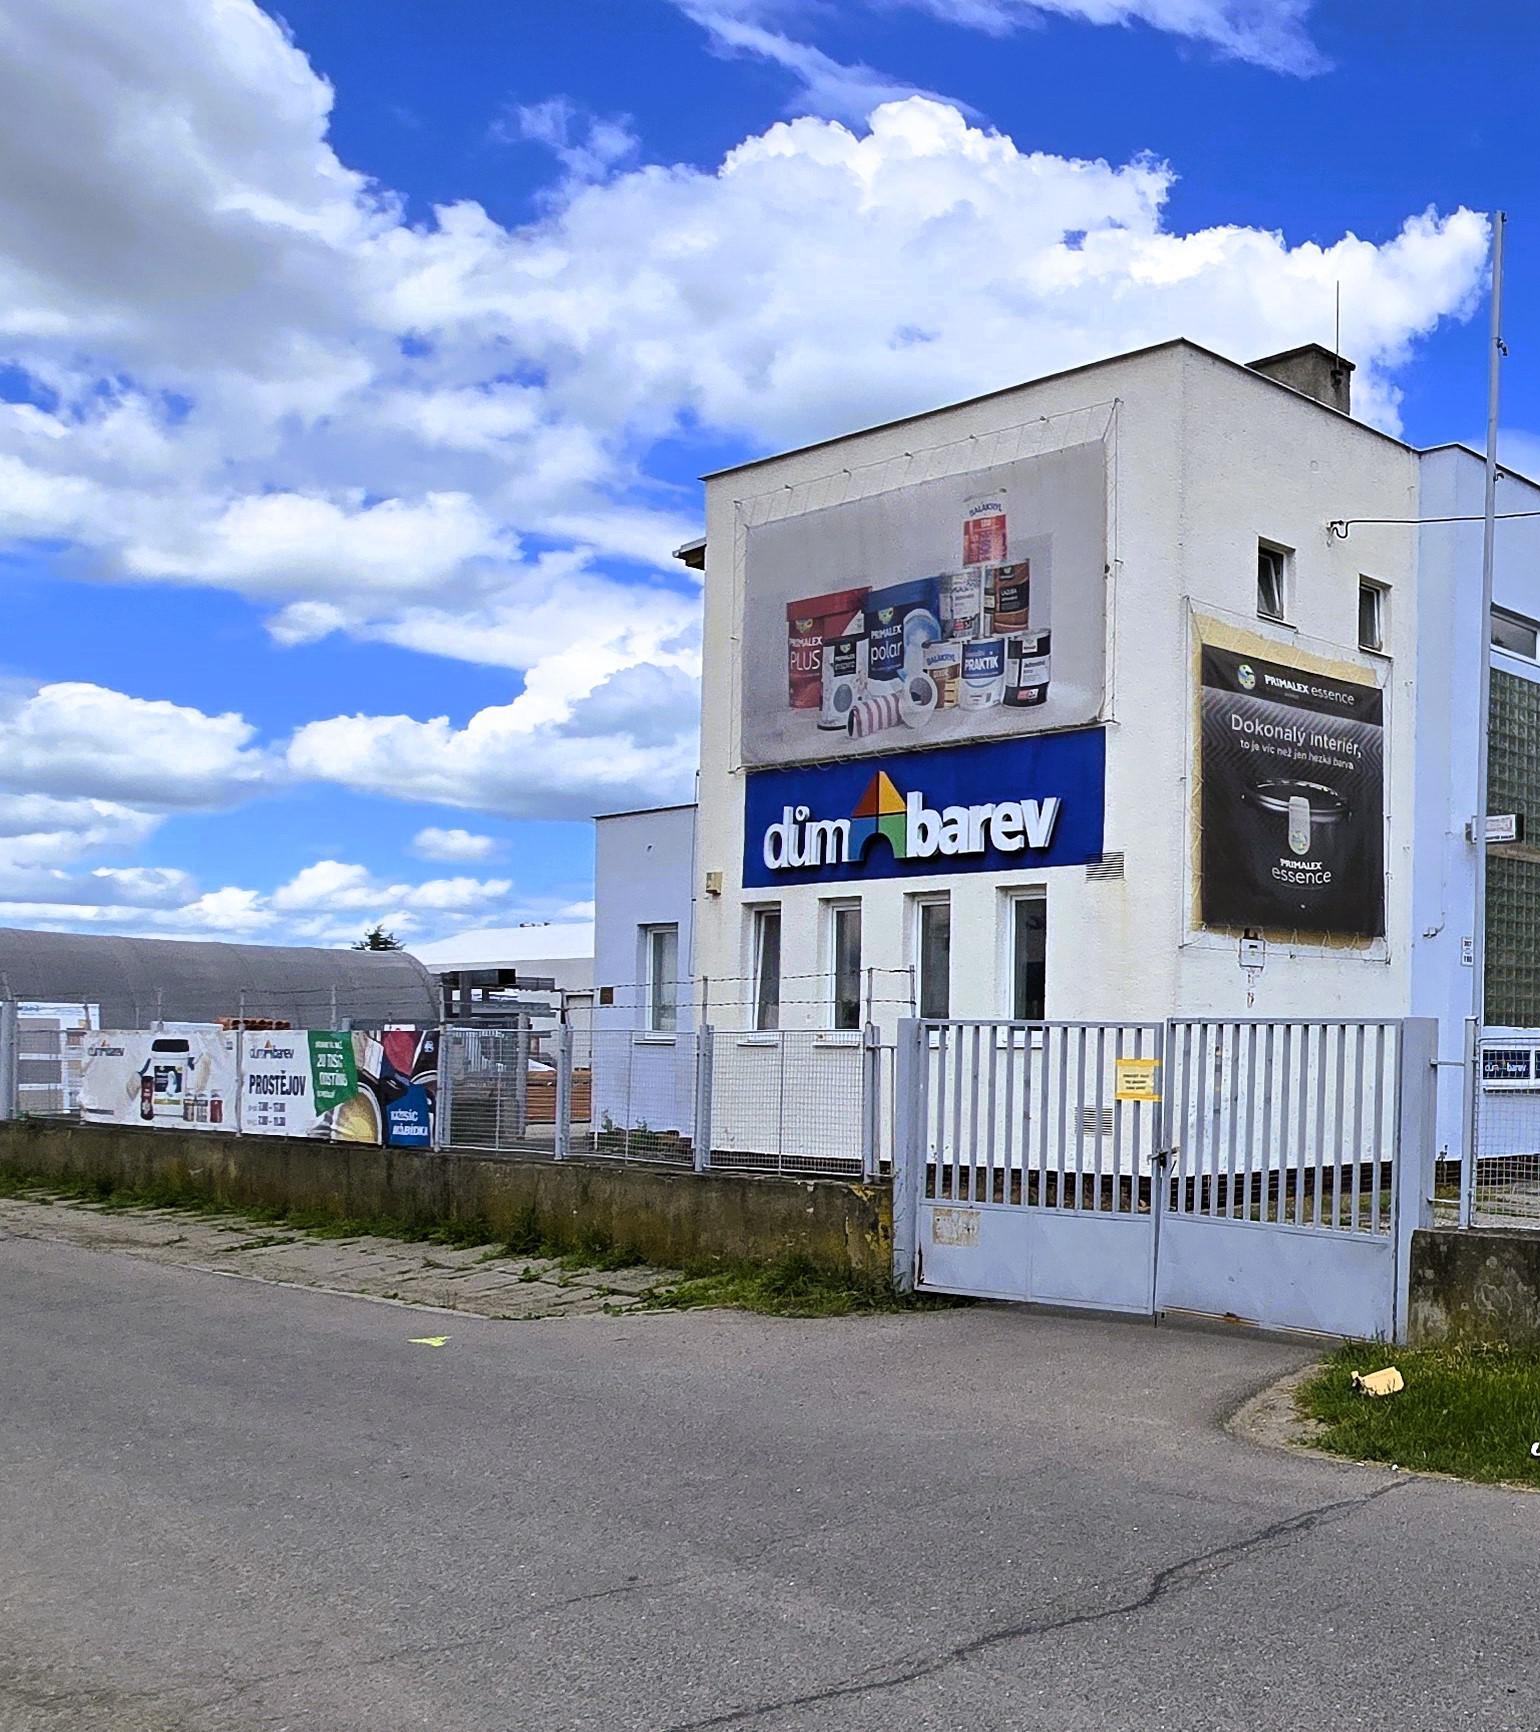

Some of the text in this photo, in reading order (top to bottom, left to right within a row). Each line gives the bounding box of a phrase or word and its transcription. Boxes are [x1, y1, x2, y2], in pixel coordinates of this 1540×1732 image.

[790, 650, 821, 670] PLUS
[870, 641, 903, 665] polar
[1264, 674, 1355, 705] PRIMALEX essence
[1231, 713, 1362, 759] Dokonalý interiér,
[1240, 738, 1250, 749] to
[1251, 740, 1260, 752] je
[1293, 749, 1307, 760] jen
[763, 791, 1061, 869] dům barev
[1271, 867, 1332, 885] essence
[1280, 857, 1323, 871] PRIMALEX
[248, 1069, 307, 1097] PROSTĚJOV
